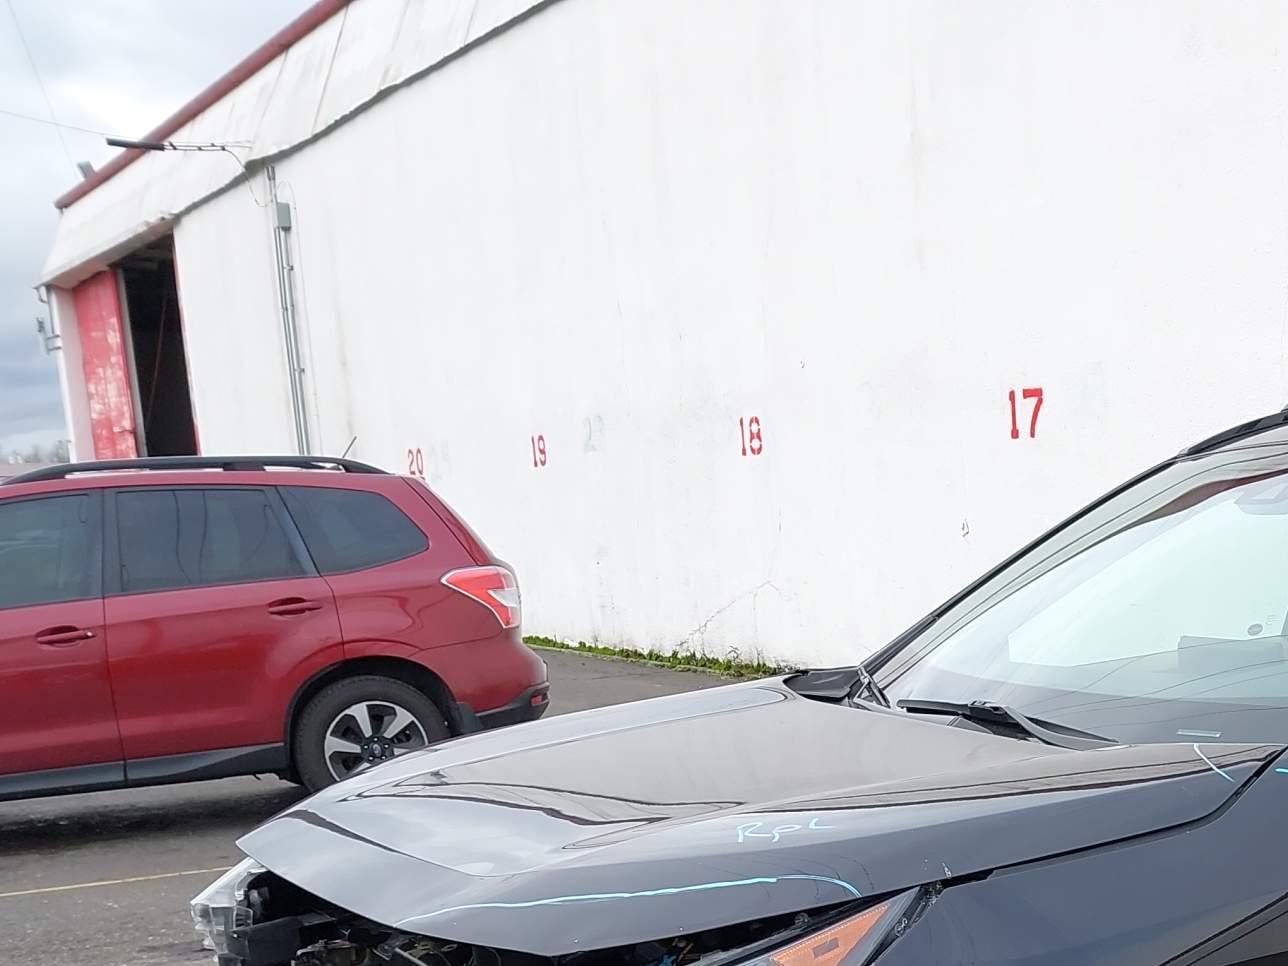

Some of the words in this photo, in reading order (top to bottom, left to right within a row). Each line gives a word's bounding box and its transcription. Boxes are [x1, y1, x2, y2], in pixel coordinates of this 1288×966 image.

[1008, 387, 1044, 440] 17
[531, 434, 547, 468] 19
[739, 415, 763, 457] 18
[407, 447, 424, 476] 20
